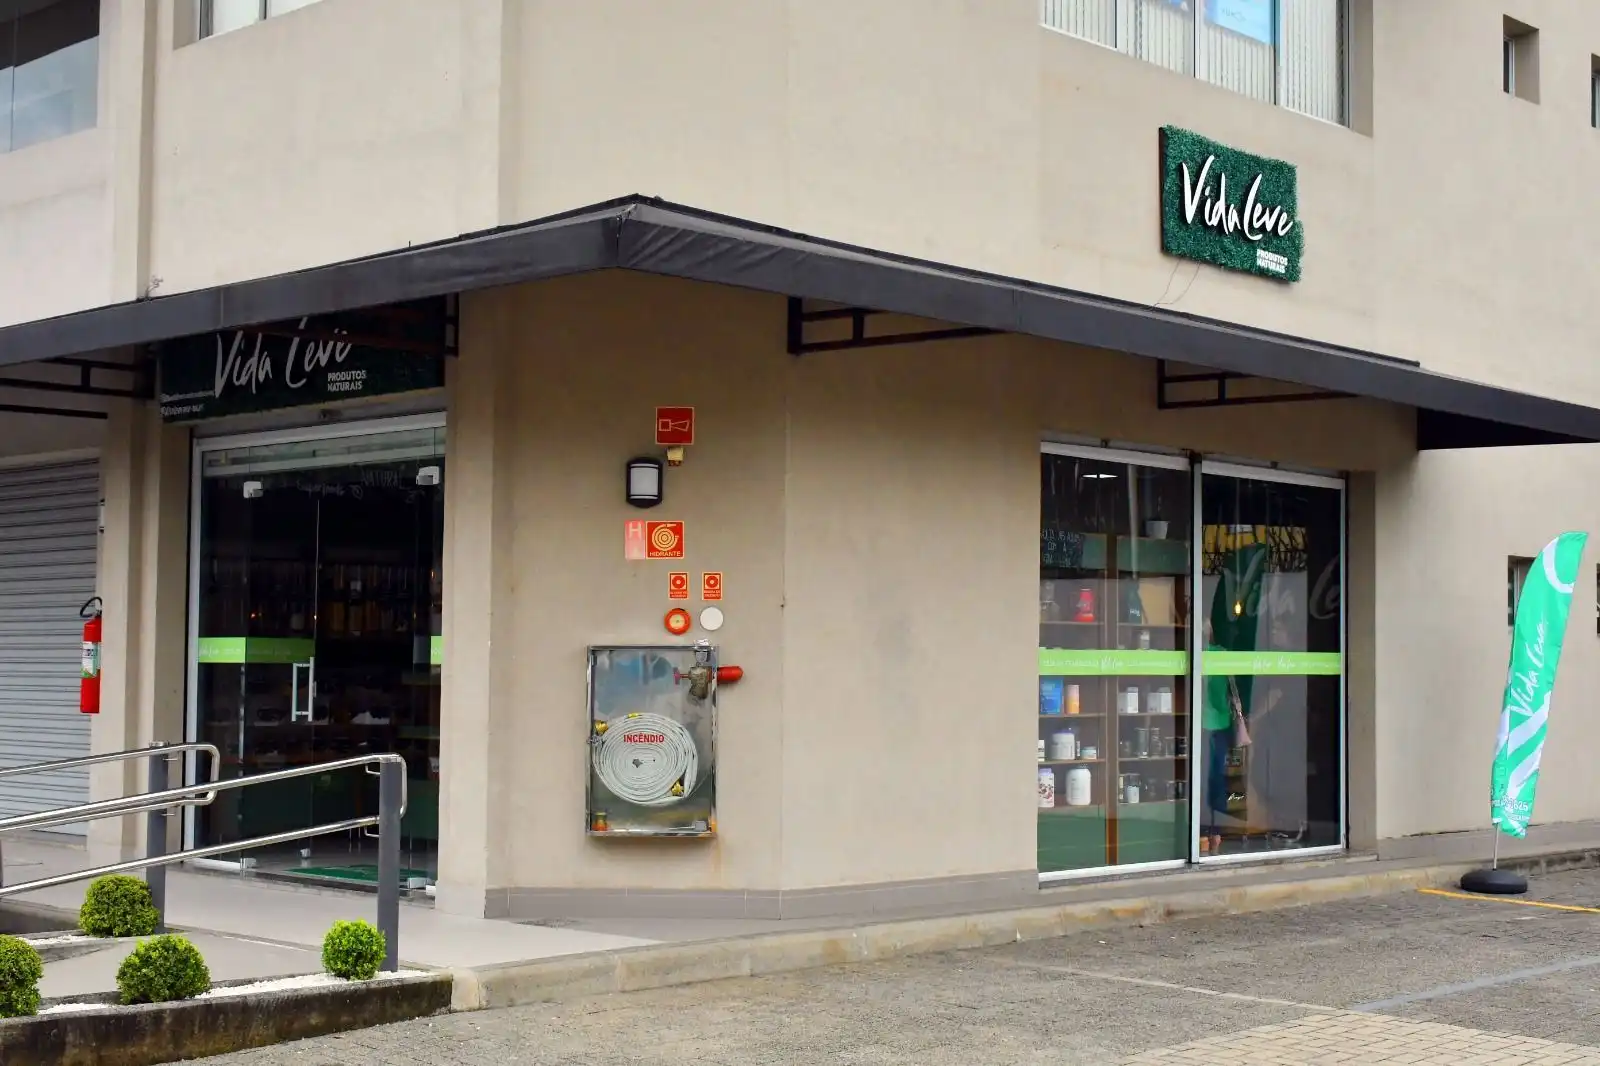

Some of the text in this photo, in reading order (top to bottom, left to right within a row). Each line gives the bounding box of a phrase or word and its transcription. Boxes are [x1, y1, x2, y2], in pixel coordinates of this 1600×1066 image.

[1182, 155, 1294, 241] Vida Leve
[1256, 249, 1288, 265] PRODUTOS
[1256, 258, 1286, 273] NATURAIS
[214, 330, 273, 398] Vida
[327, 369, 367, 381] PRODUTOS
[327, 379, 363, 391] NATURAIS
[1510, 669, 1540, 717] Vida
[623, 733, 665, 743] INCÊNDIO
